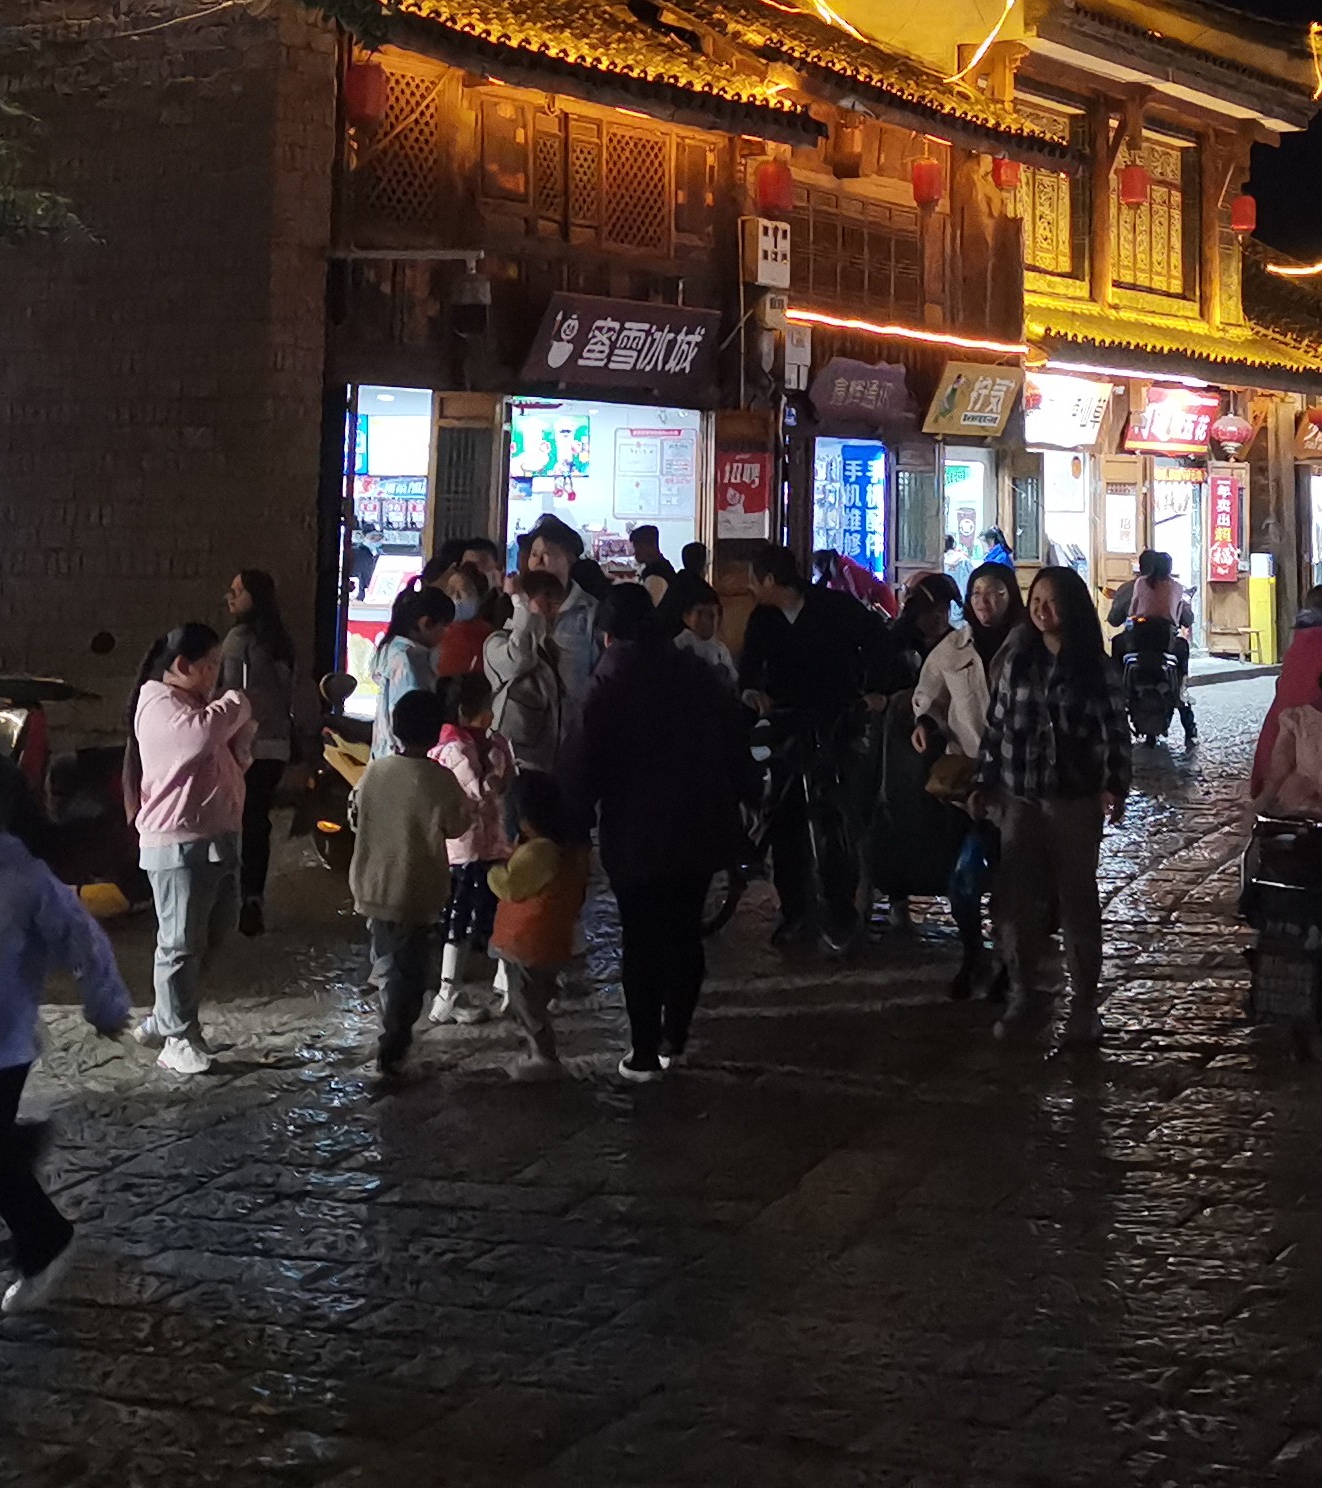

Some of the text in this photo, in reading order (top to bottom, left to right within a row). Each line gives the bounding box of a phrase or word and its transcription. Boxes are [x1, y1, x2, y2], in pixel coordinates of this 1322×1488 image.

[577, 317, 706, 374] 蜜雪冰城
[723, 463, 761, 488] 招聘
[844, 460, 863, 556] 手机维修
